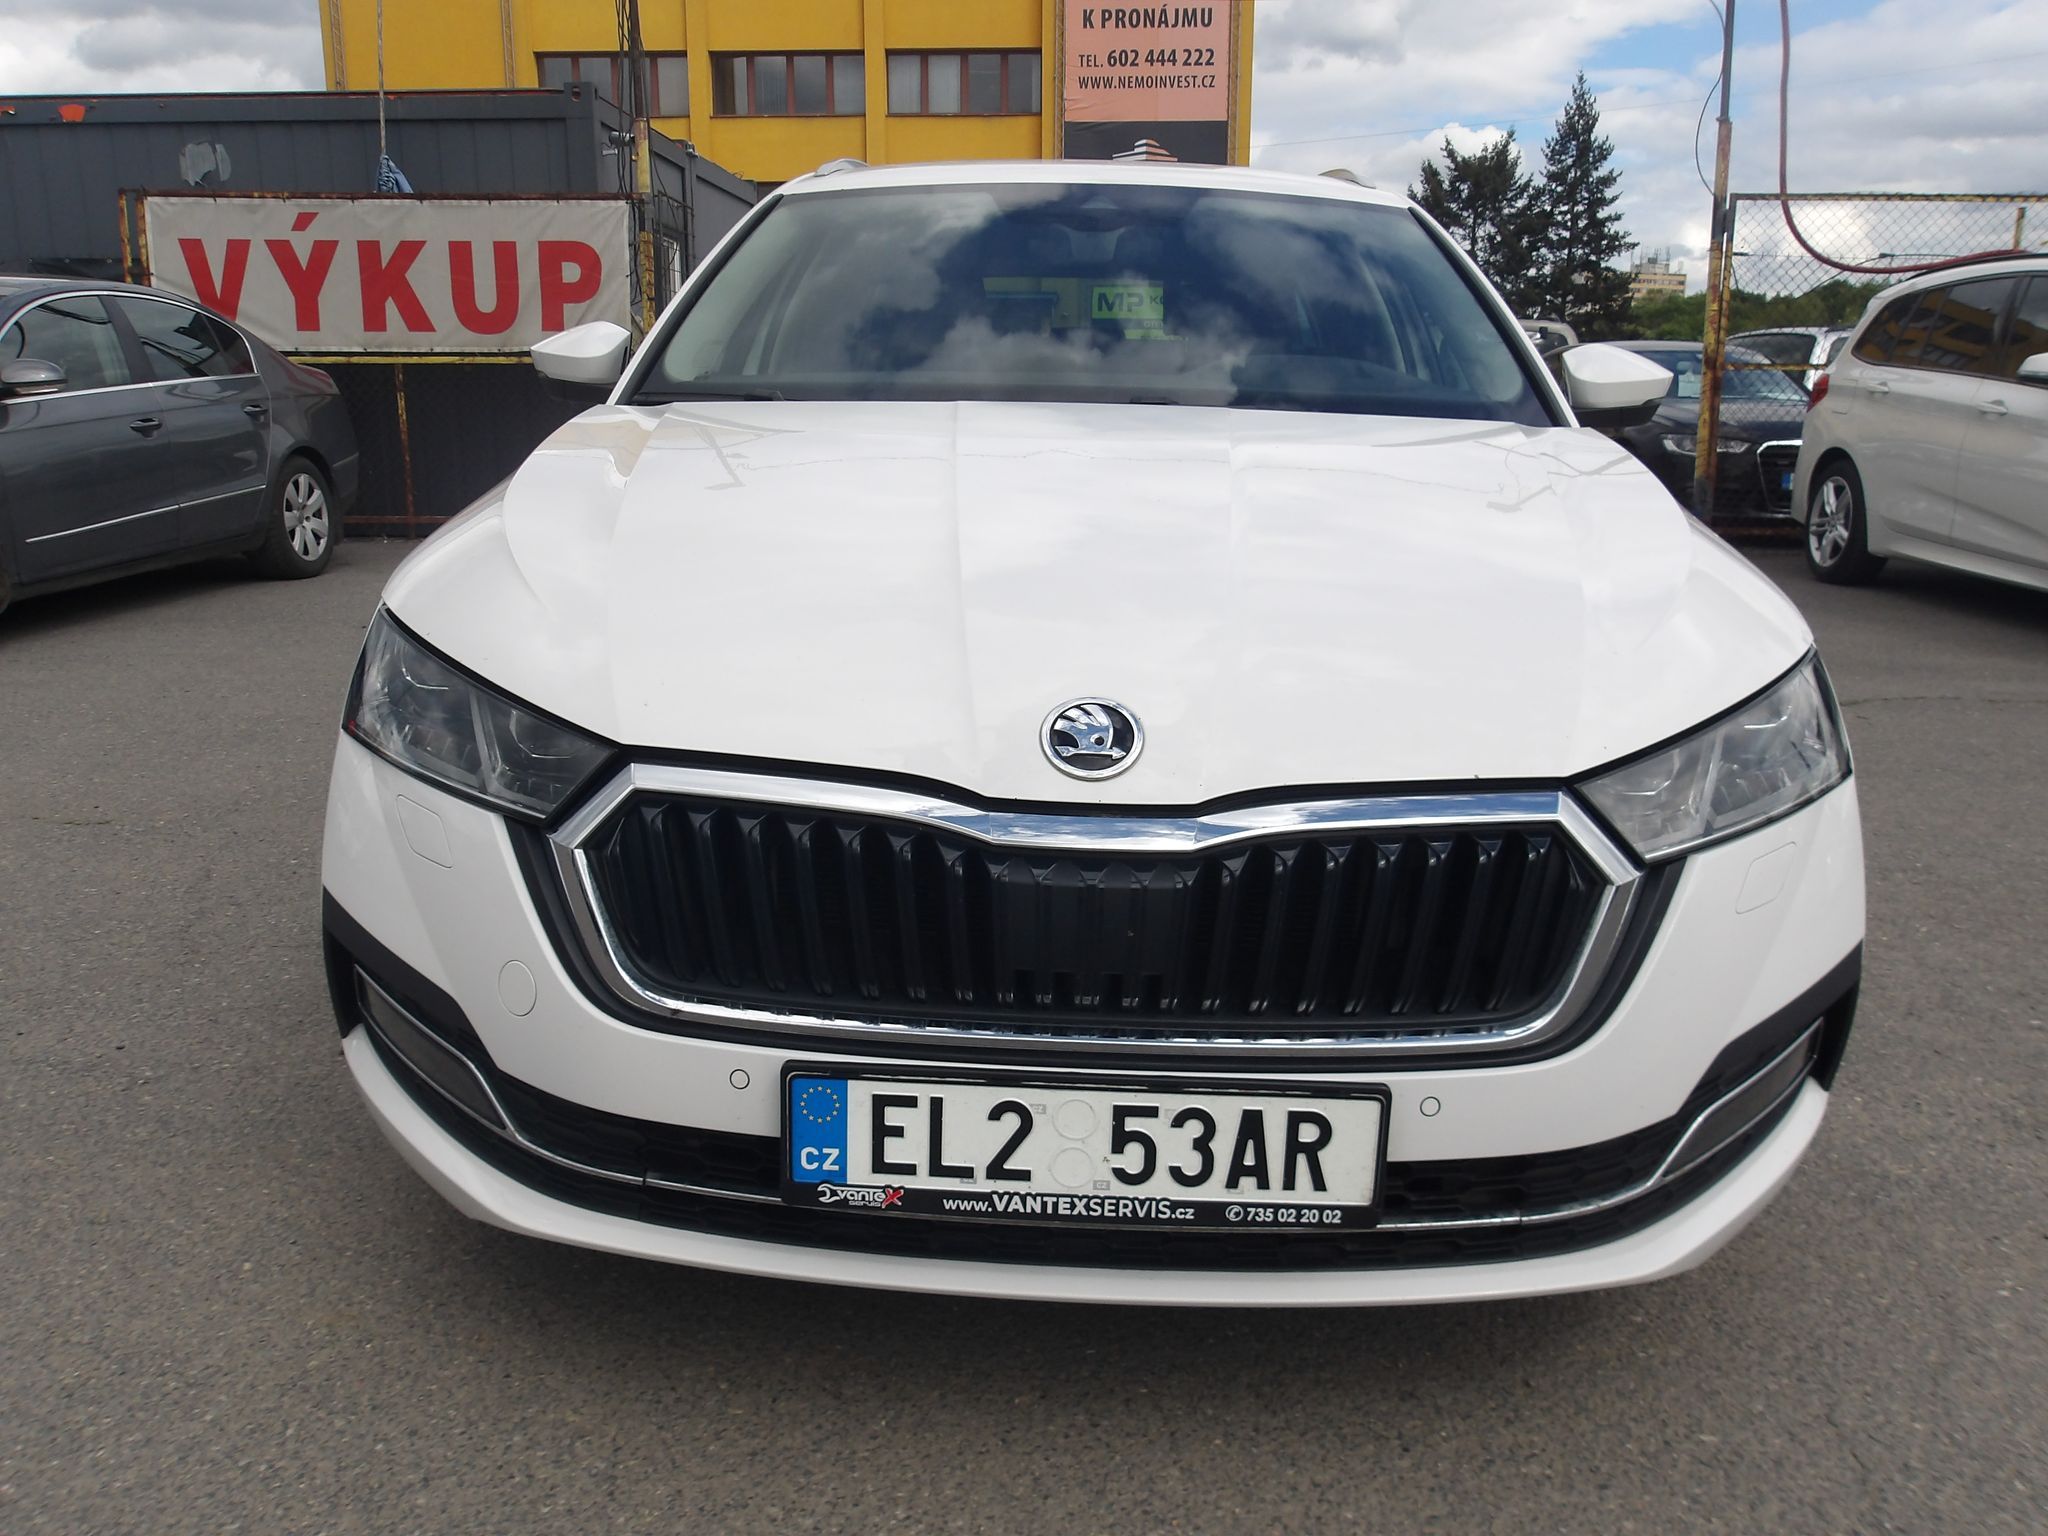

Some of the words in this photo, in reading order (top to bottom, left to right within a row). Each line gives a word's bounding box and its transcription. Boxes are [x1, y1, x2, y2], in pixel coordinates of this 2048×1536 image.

[1082, 8, 1095, 29] K
[1101, 4, 1213, 29] PRONÁJMU
[1078, 54, 1104, 67] TEL.
[1107, 49, 1139, 67] 602
[1145, 49, 1178, 67] 444
[1182, 48, 1215, 67] 222
[1078, 75, 1216, 89] WWW.NEMOINVEST.CZ
[177, 211, 603, 336] VÝKUP
[1097, 292, 1143, 312] MP
[871, 1093, 1034, 1182] EL2
[1110, 1103, 1333, 1192] 53AR
[800, 1146, 840, 1172] CZ
[943, 1193, 1195, 1220] www.VANTEXSERVIS.cz
[1246, 1207, 1274, 1222] 735
[1277, 1208, 1297, 1223] 02
[1300, 1209, 1319, 1223] 20
[1322, 1209, 1342, 1224] 02
